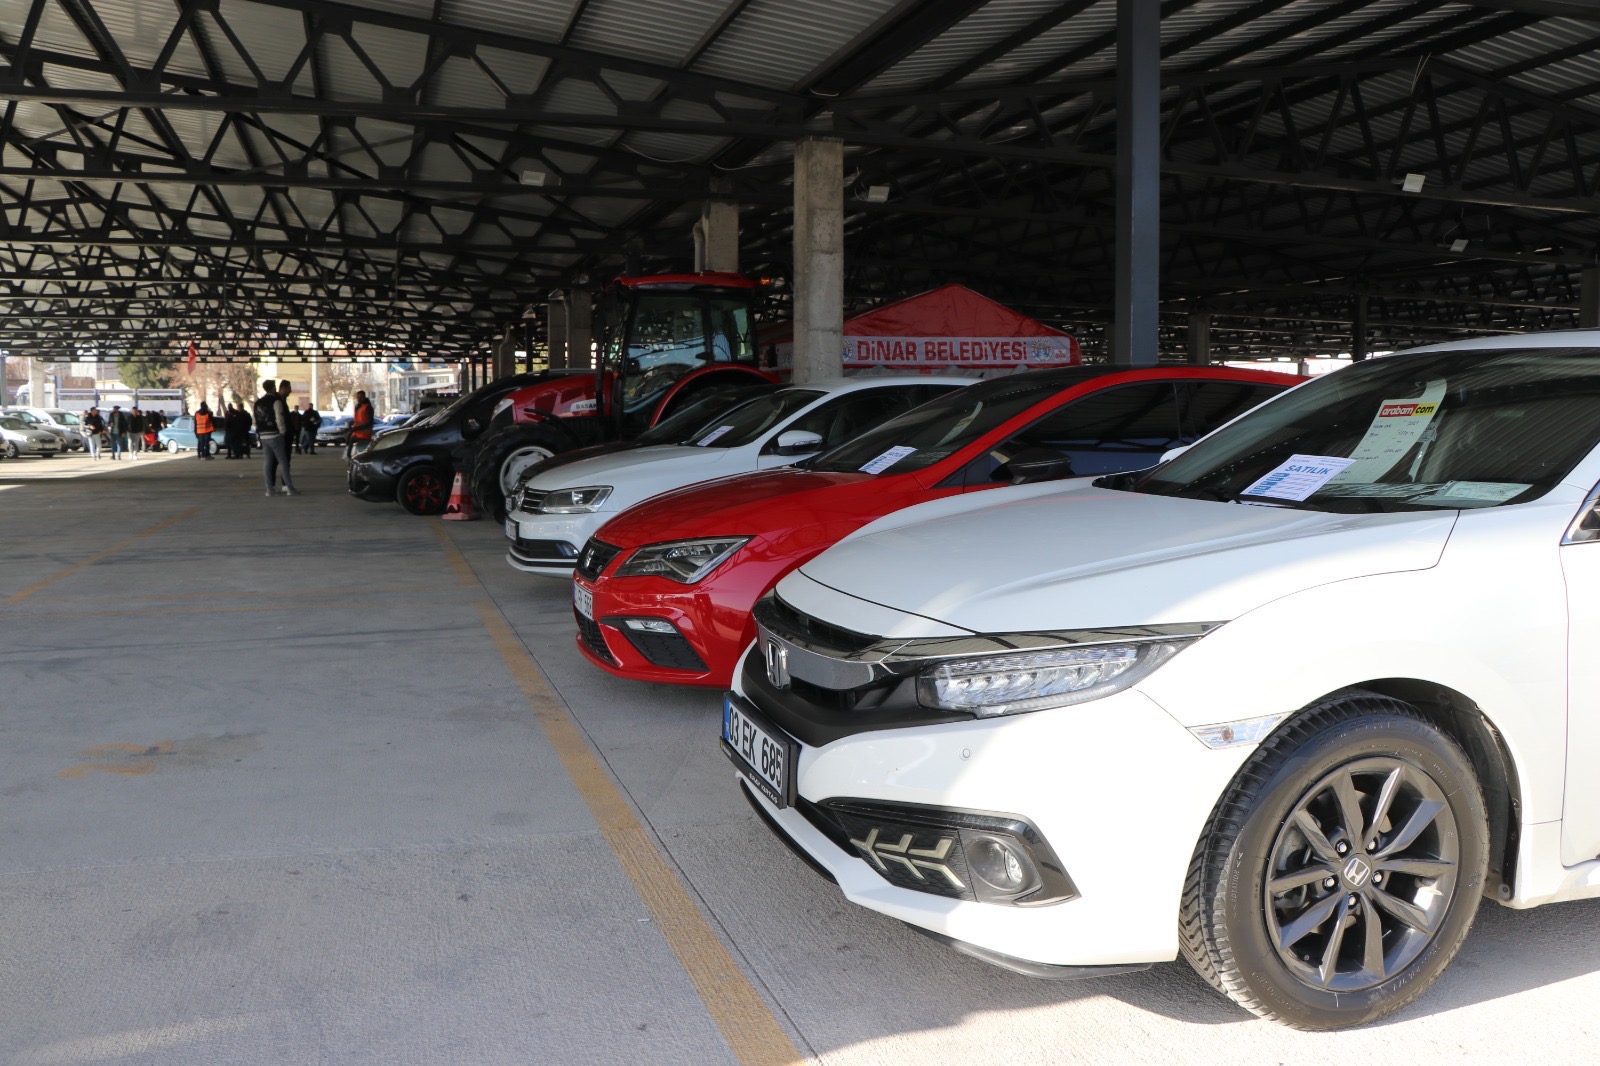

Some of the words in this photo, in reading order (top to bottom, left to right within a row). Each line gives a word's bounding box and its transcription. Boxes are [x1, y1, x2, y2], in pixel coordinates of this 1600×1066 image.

[729, 706, 739, 747] 03
[742, 718, 757, 765] EK
[761, 736, 783, 788] 685
